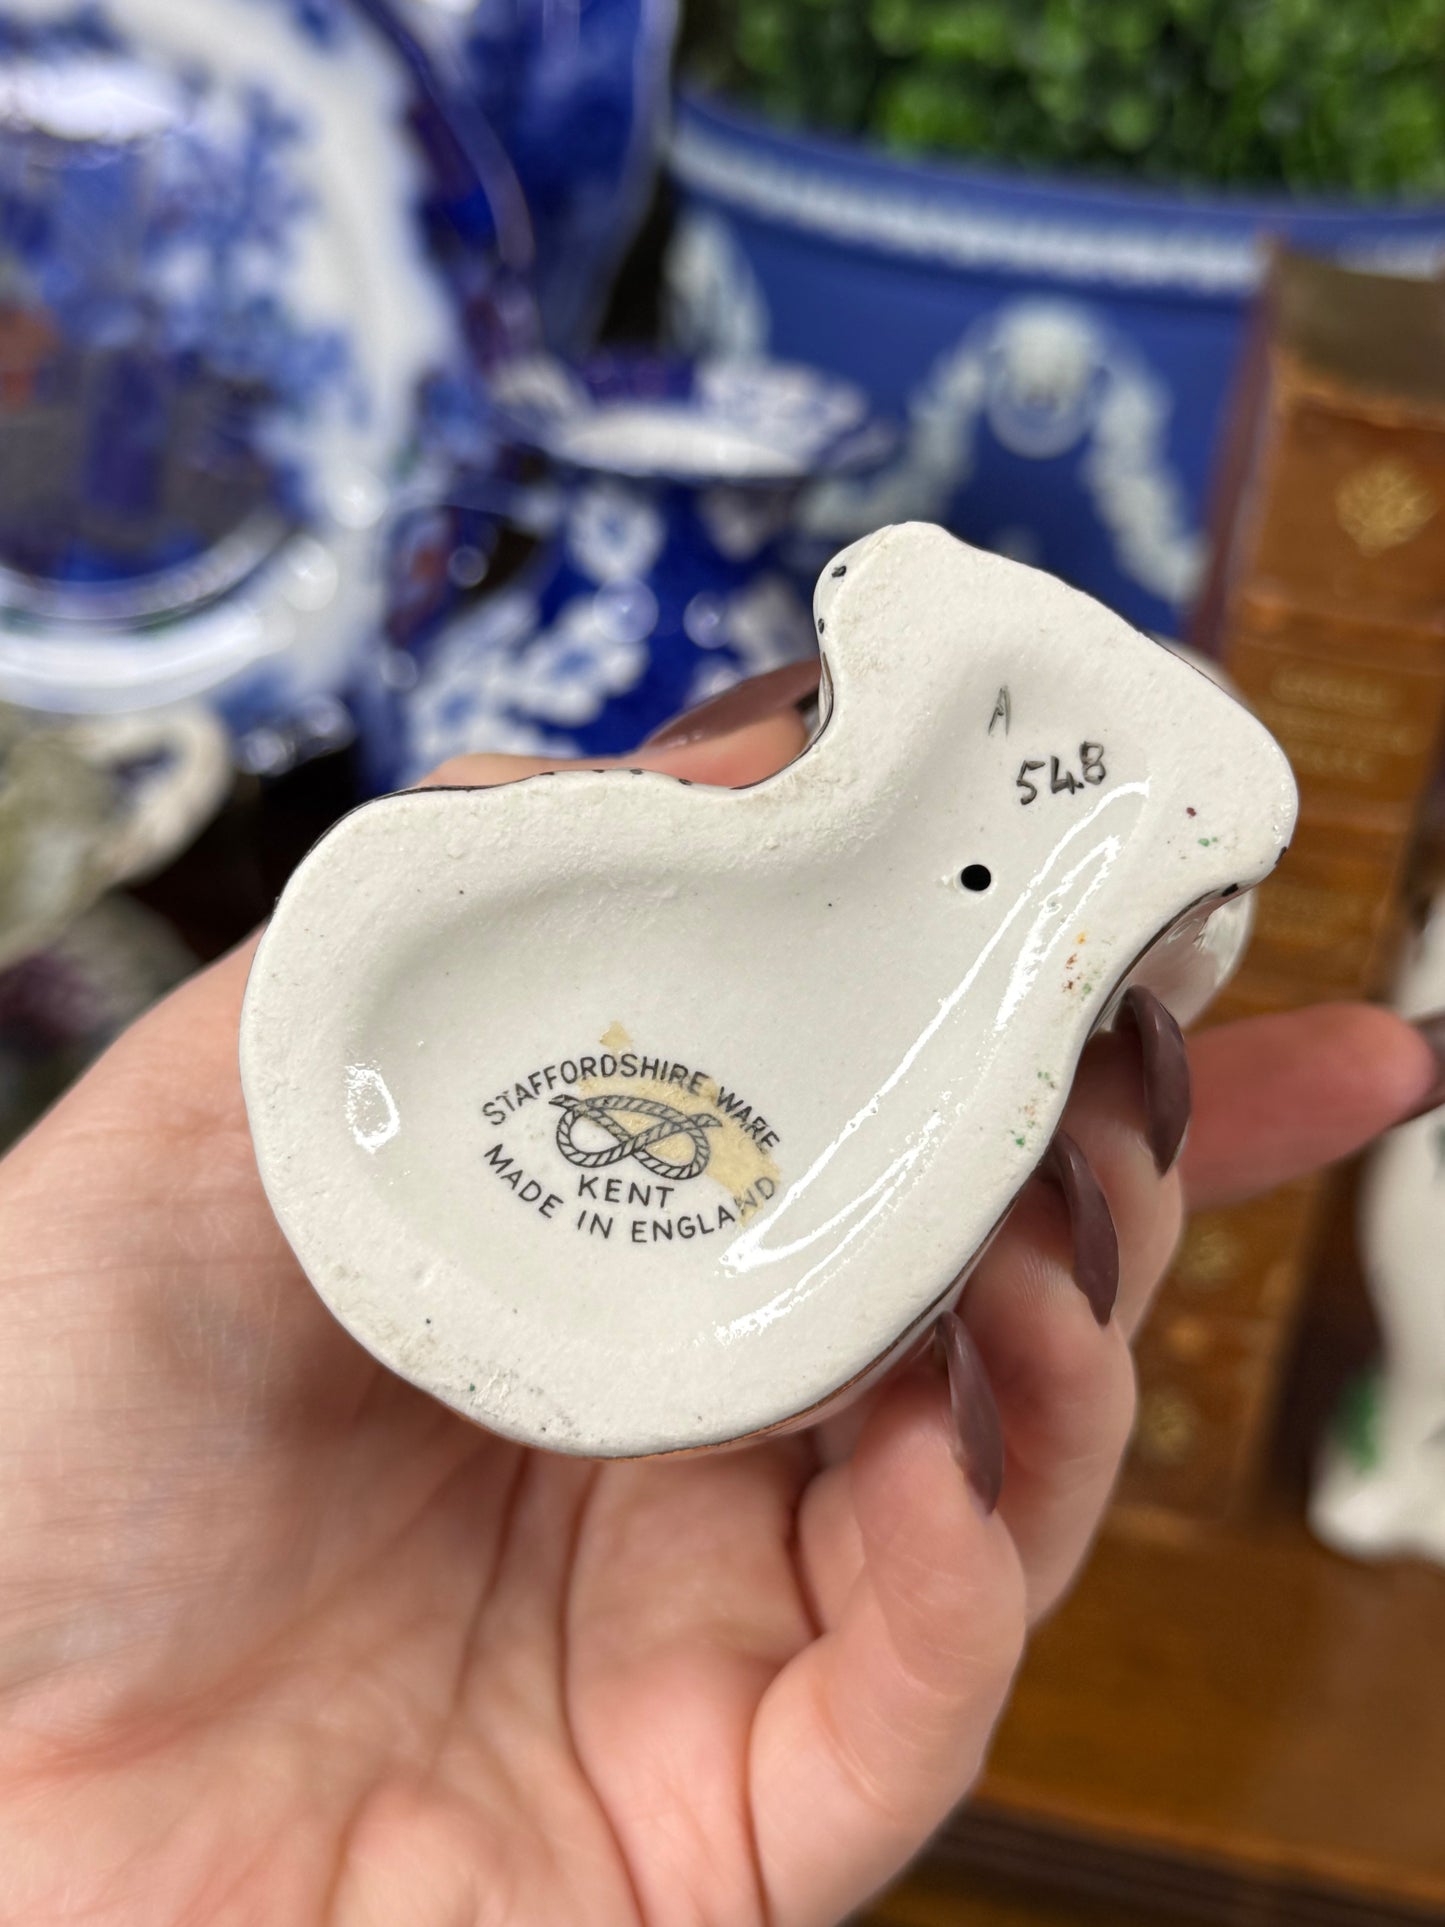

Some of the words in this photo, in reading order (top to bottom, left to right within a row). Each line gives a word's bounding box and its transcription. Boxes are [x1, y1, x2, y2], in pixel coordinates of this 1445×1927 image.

[1016, 741, 1106, 805] 548
[482, 1054, 709, 1126] STAFFORDSHIRE
[717, 1087, 780, 1155] WARE
[484, 1144, 564, 1219] MADE
[577, 1210, 613, 1239] IN
[631, 1176, 776, 1243] ENGLAND
[578, 1174, 674, 1208] KENT
